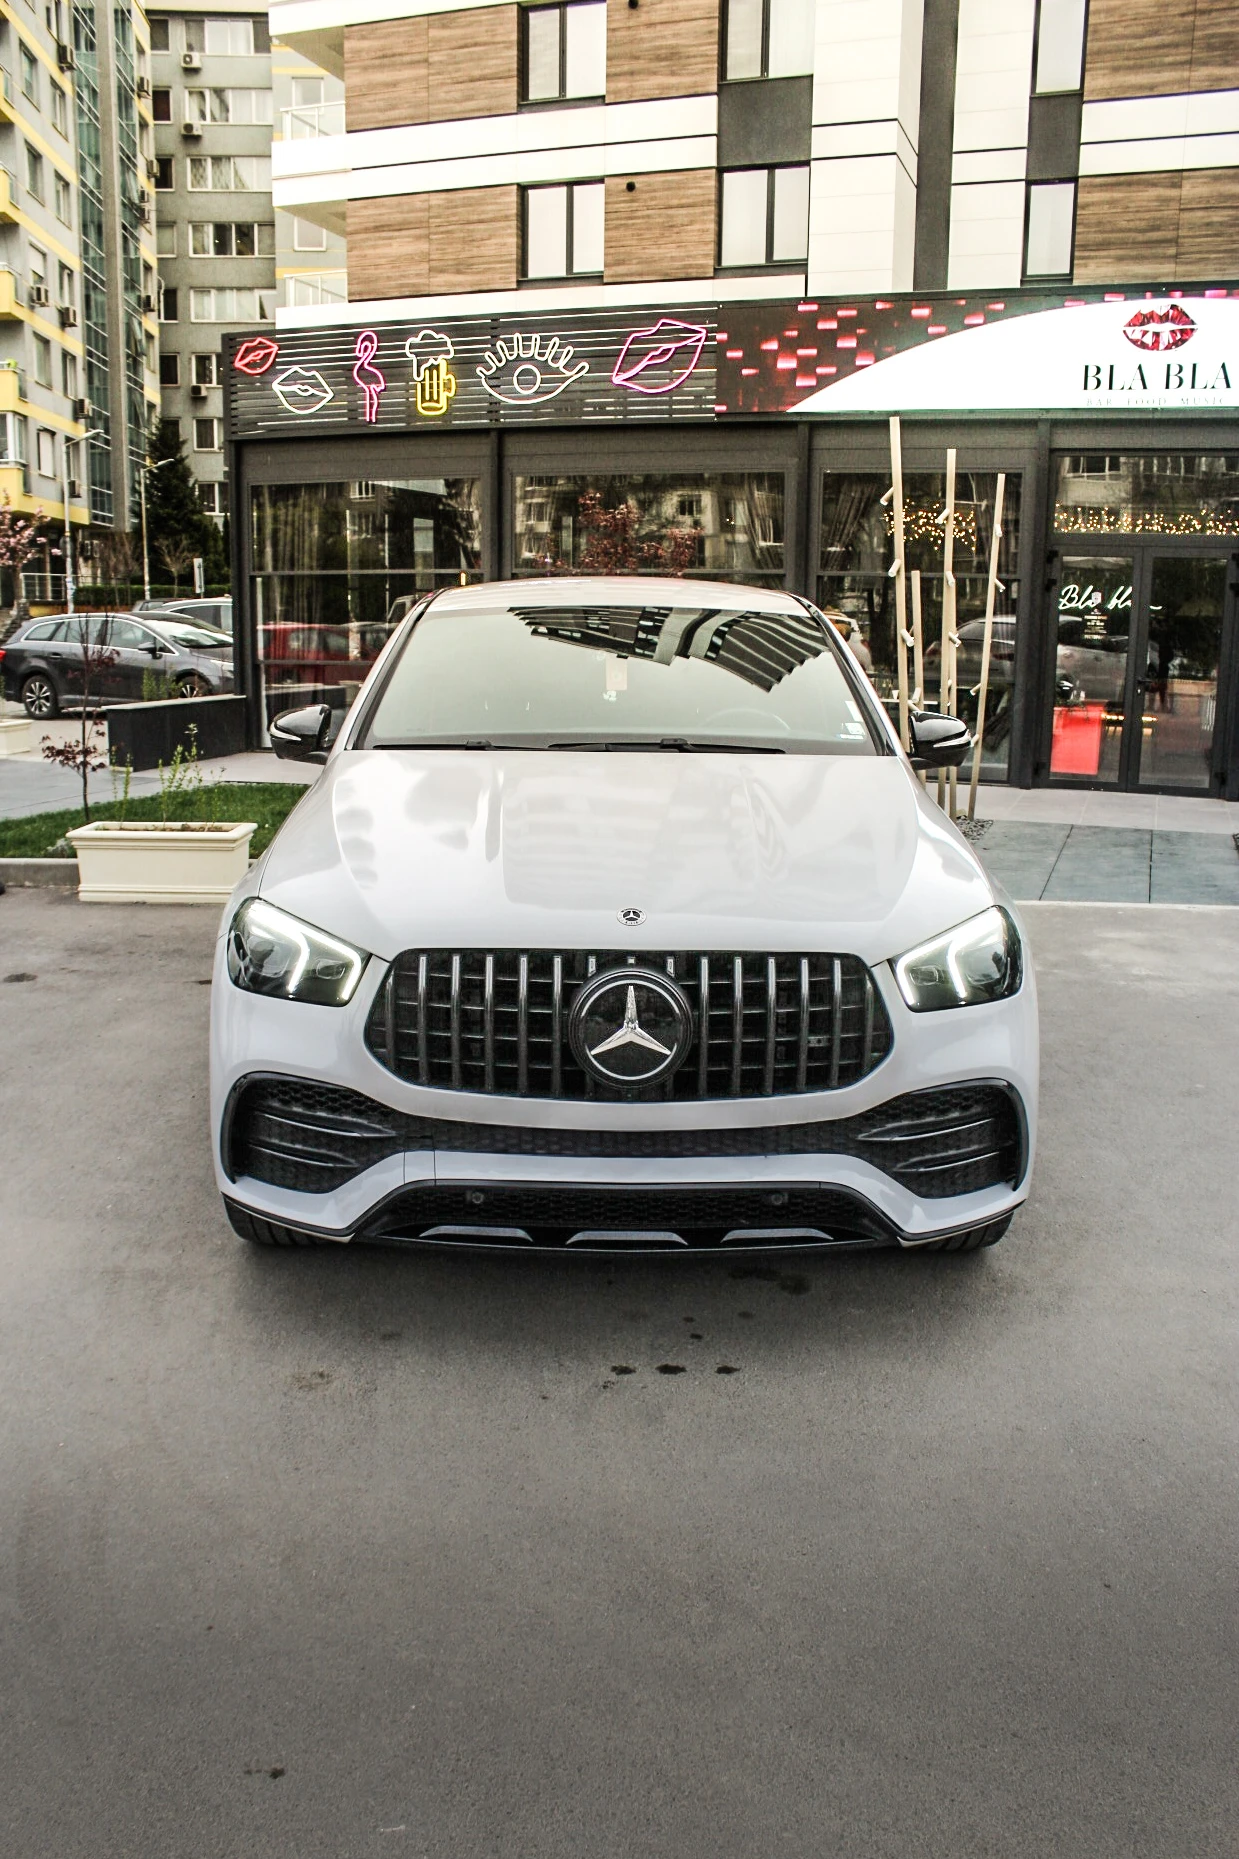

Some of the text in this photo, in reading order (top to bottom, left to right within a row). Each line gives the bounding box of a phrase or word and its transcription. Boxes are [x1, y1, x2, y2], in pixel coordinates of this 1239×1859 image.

[1083, 362, 1231, 391] BLA BLA
[1086, 397, 1224, 407] BAR FOOD MUSIC
